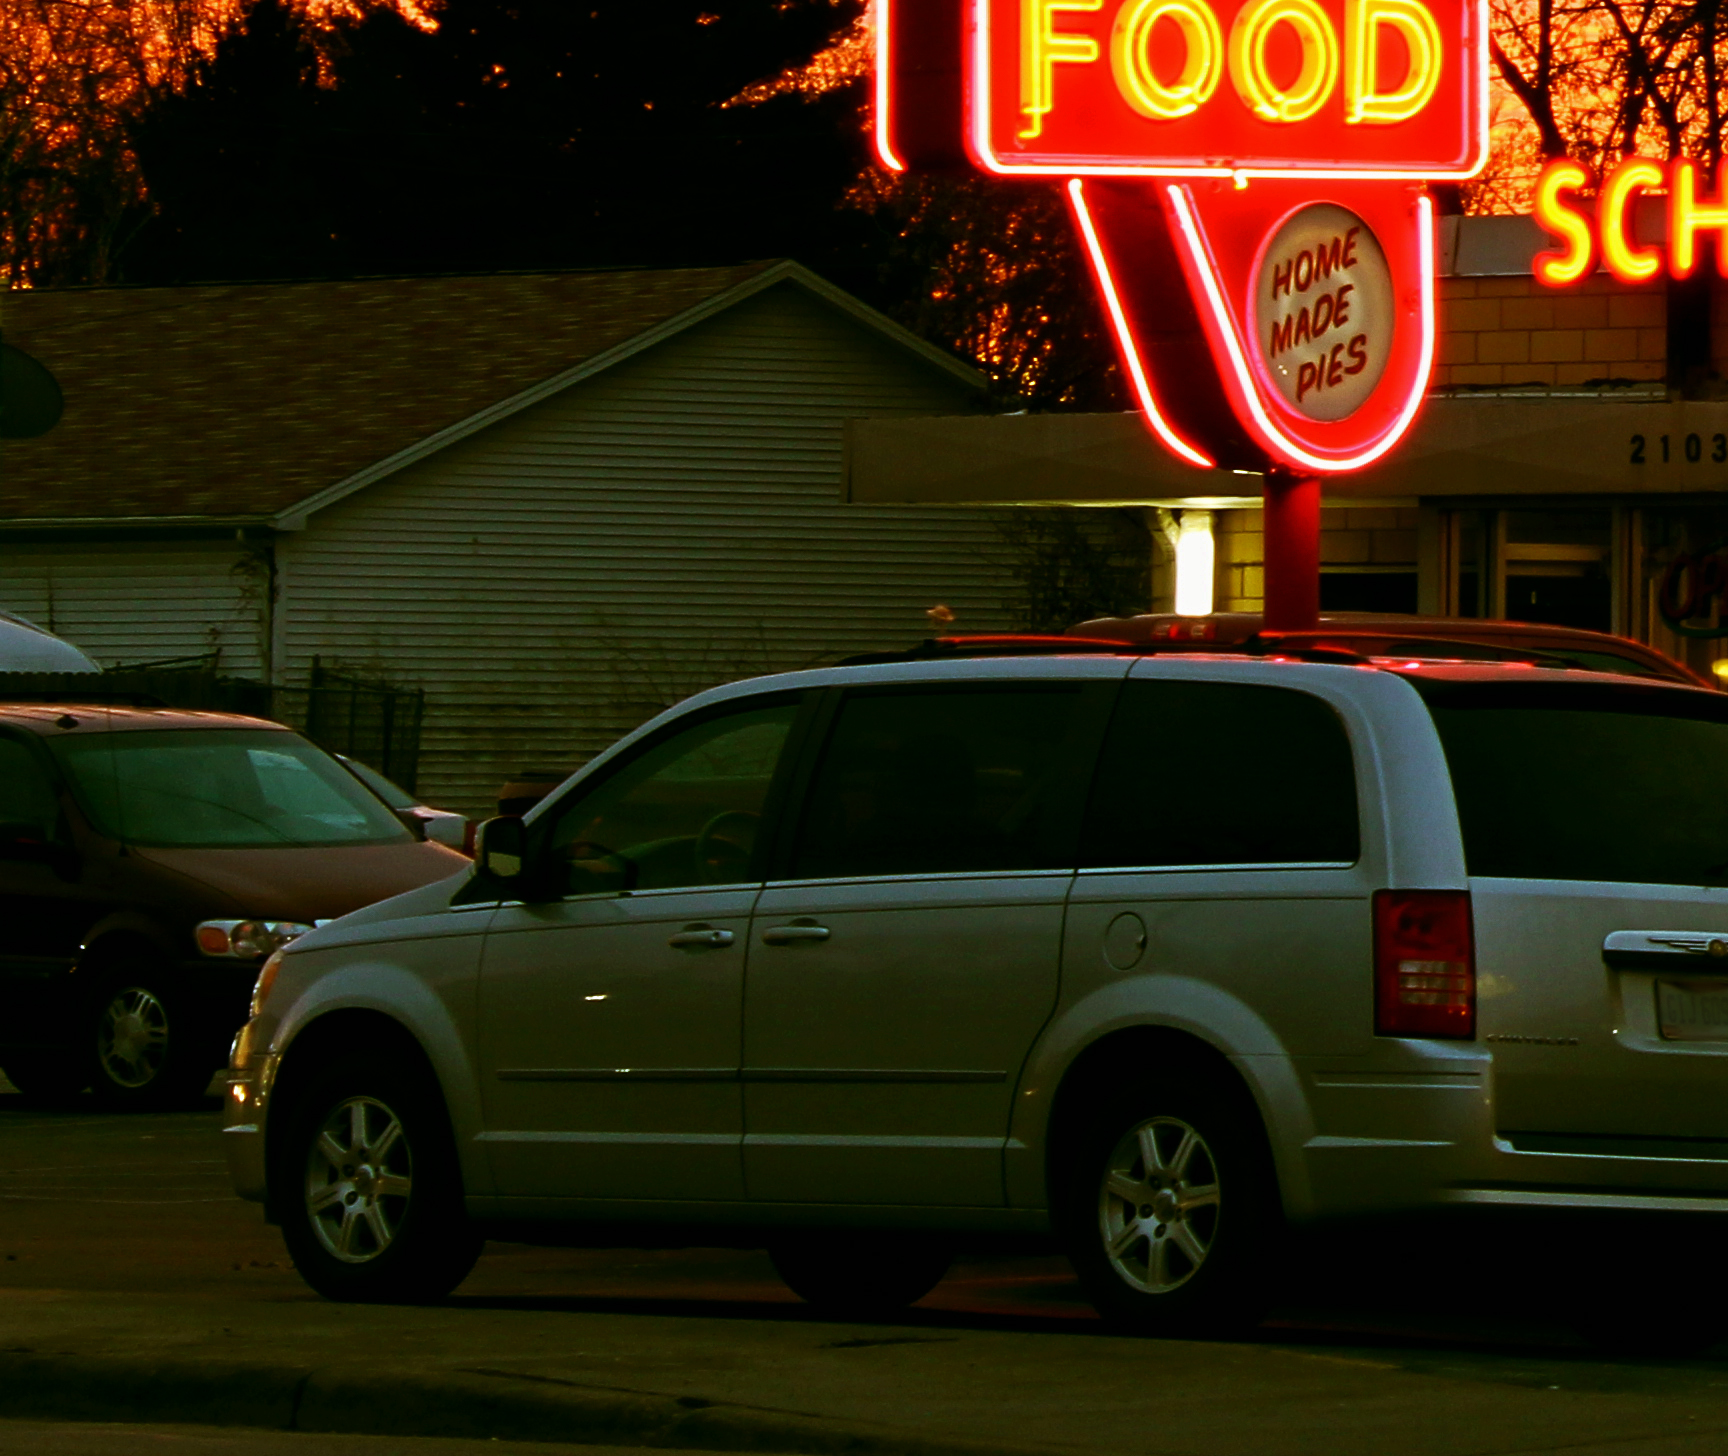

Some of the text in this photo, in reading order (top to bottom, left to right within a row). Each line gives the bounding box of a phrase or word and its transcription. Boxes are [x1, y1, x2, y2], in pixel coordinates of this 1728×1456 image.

[1272, 226, 1360, 300] HOME
[1270, 284, 1354, 358] MADE
[1296, 333, 1368, 403] PIES
[1630, 433, 1727, 463] 2103
